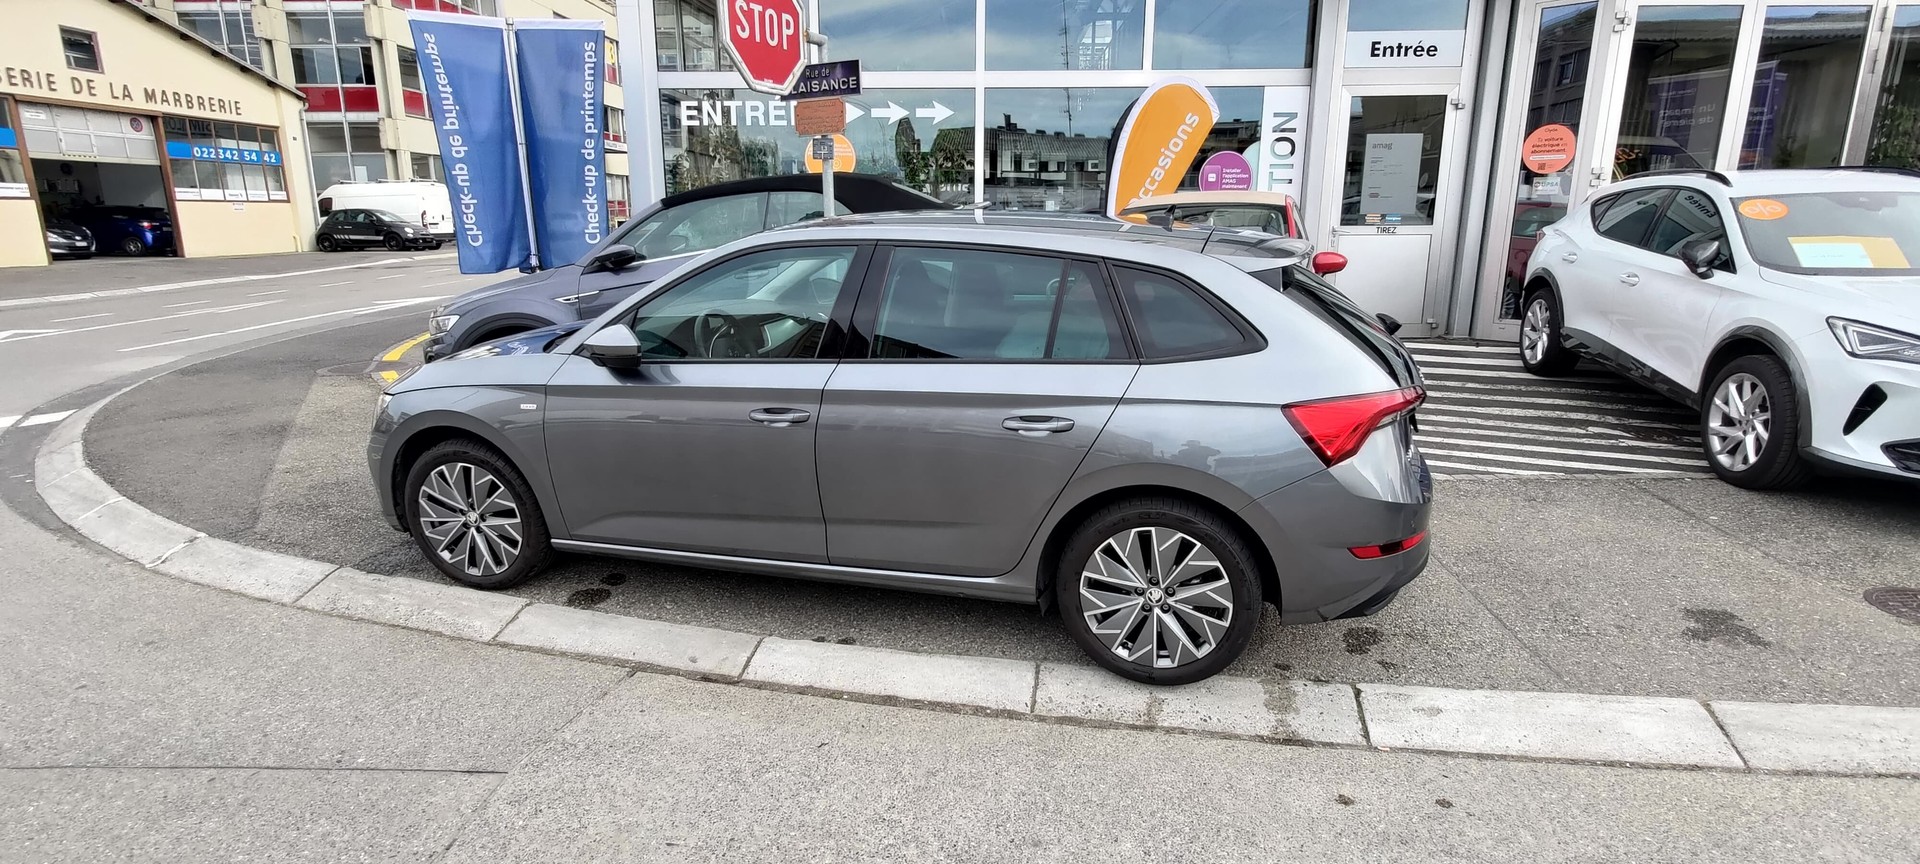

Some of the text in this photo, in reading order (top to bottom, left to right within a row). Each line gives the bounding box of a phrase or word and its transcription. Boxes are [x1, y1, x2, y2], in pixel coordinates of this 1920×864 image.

[735, 0, 795, 50] STOP
[1370, 40, 1438, 58] Entrée
[0, 67, 243, 116] ERIE DE LA MARBRERIE
[805, 66, 831, 78] Rue de
[193, 147, 277, 163] 022 342 54 42
[580, 41, 601, 244] Check-up de printemps
[1128, 112, 1200, 205] ccasions
